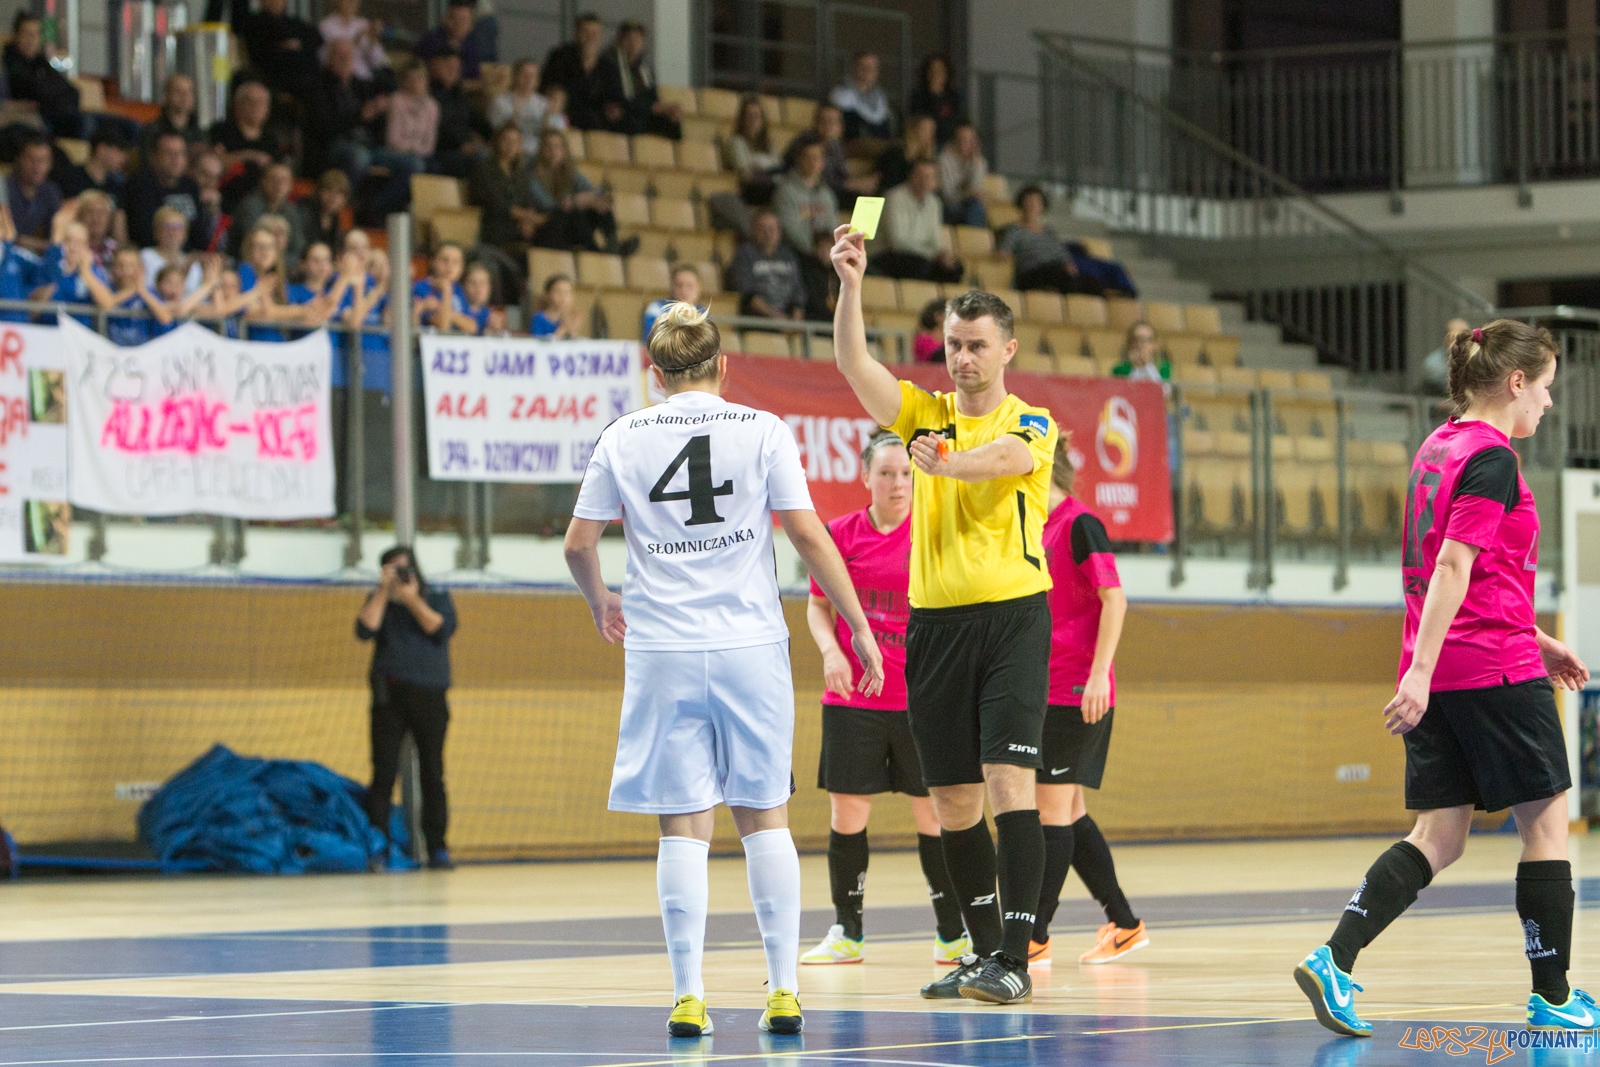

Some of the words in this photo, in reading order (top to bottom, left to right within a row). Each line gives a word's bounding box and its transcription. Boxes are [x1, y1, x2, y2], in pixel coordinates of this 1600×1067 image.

[629, 410, 757, 429] lex-kancelaria.pl
[648, 434, 734, 526] 4
[647, 527, 755, 555] SŁOMNICZANKA
[1403, 469, 1443, 568] 17
